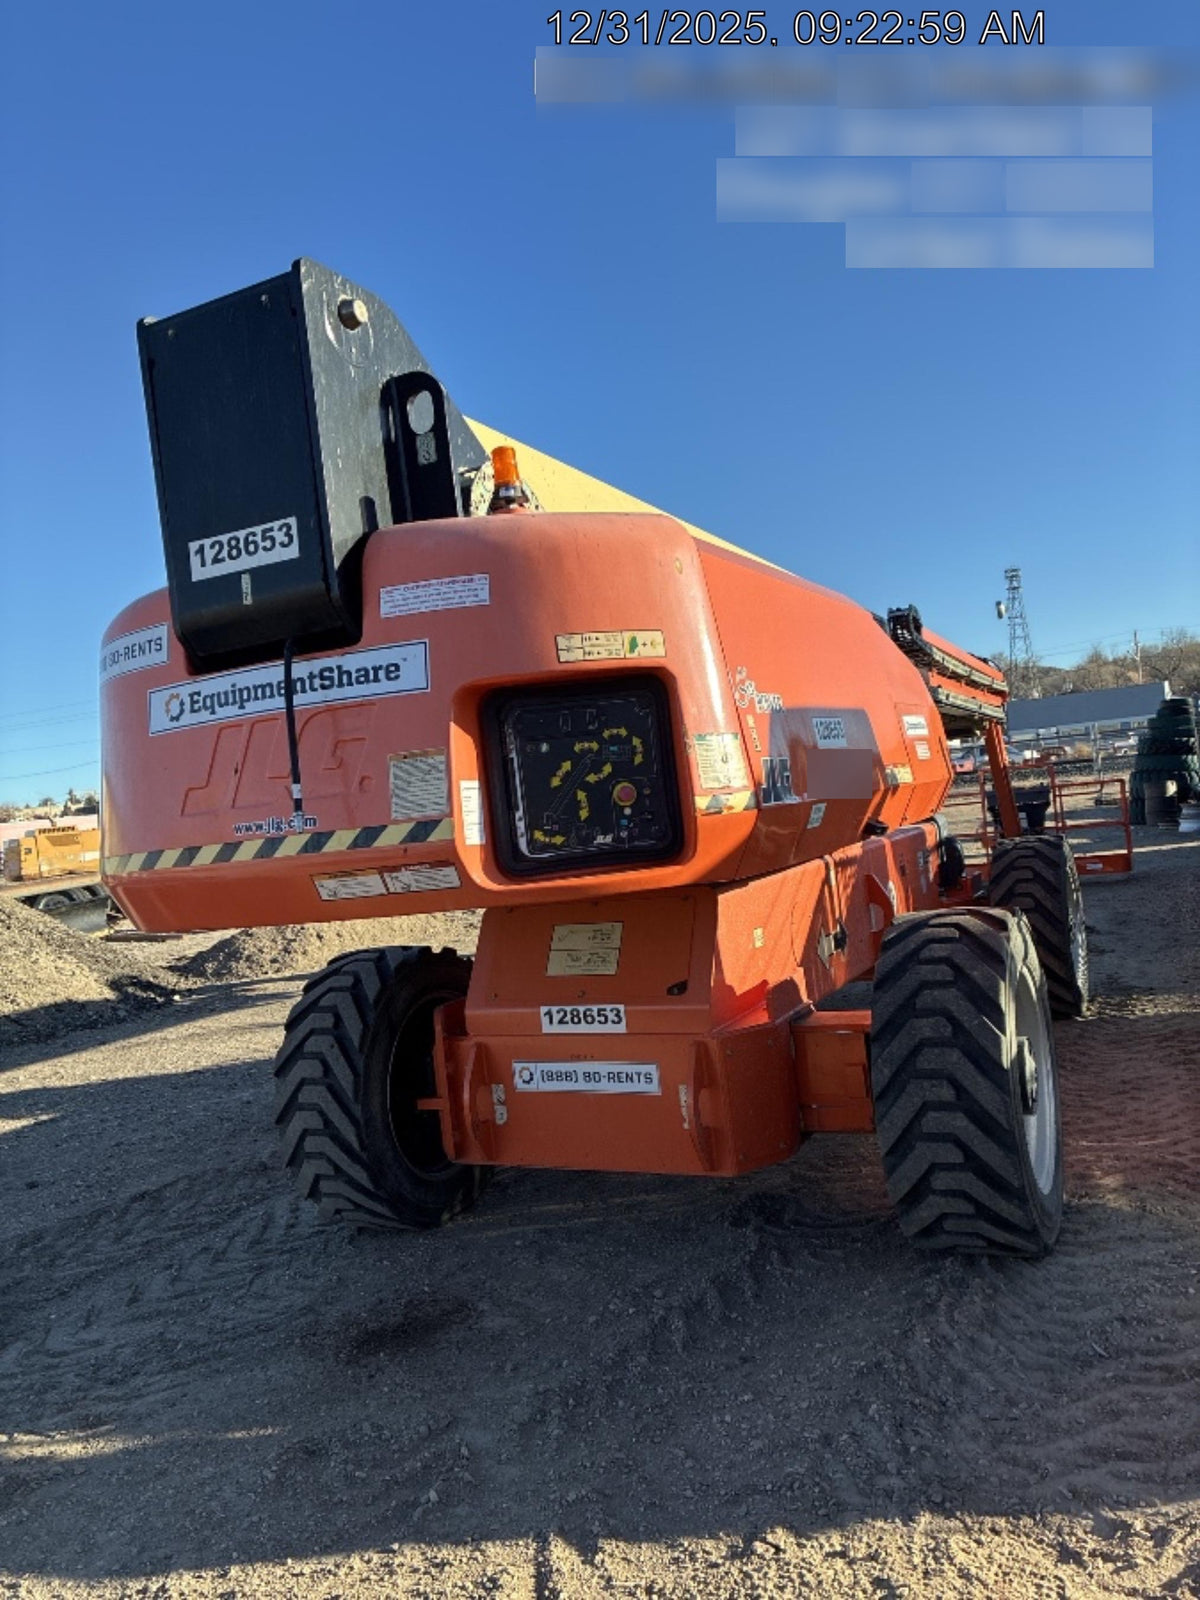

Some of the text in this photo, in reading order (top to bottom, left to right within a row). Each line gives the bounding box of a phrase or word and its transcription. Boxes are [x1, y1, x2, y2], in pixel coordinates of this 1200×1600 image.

[193, 521, 295, 569] 128653
[188, 663, 402, 716] EquipmentShare
[233, 815, 318, 836] www.jlg.cm
[543, 1006, 624, 1026] 128653
[540, 1069, 654, 1085] (888) 80-RENTS
